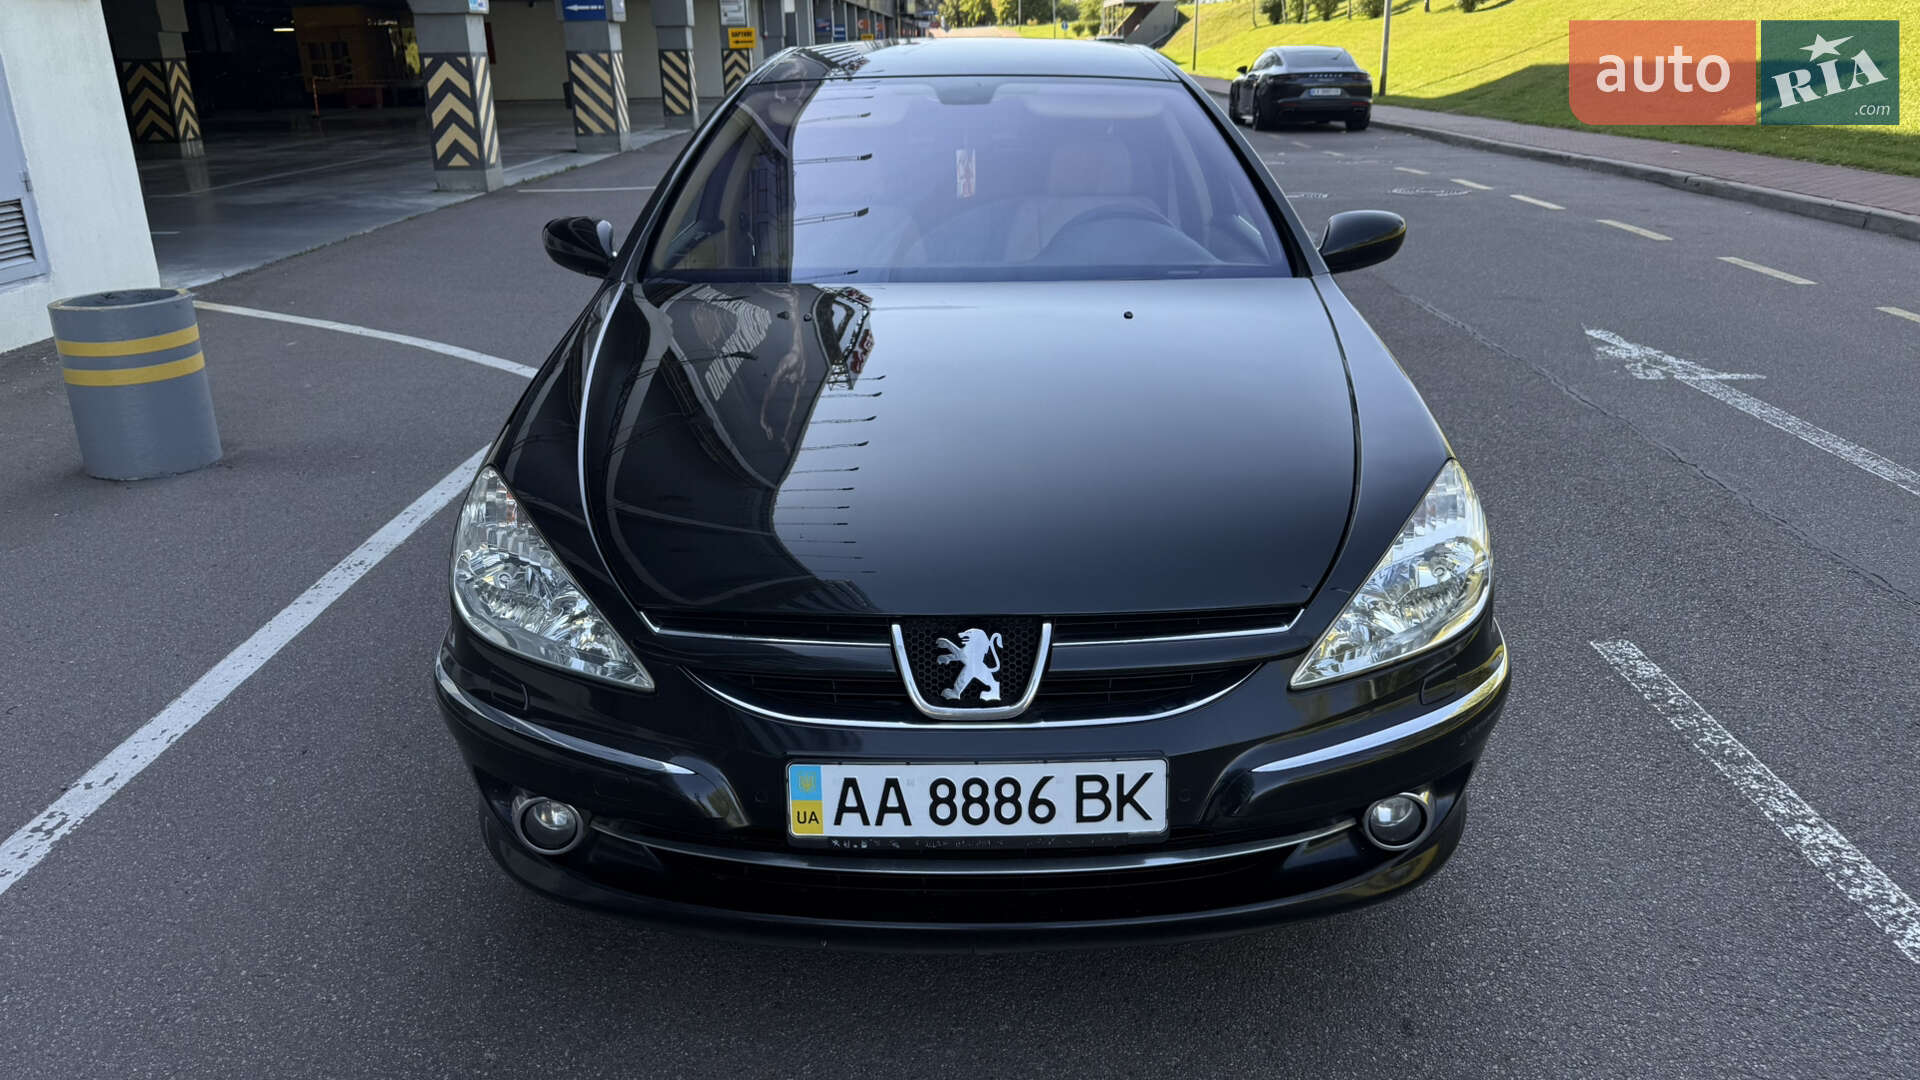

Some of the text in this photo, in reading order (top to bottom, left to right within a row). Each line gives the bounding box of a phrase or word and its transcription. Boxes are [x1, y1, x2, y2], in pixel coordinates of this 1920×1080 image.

[833, 771, 1155, 827] AA 8886 BK
[796, 810, 820, 825] UA
